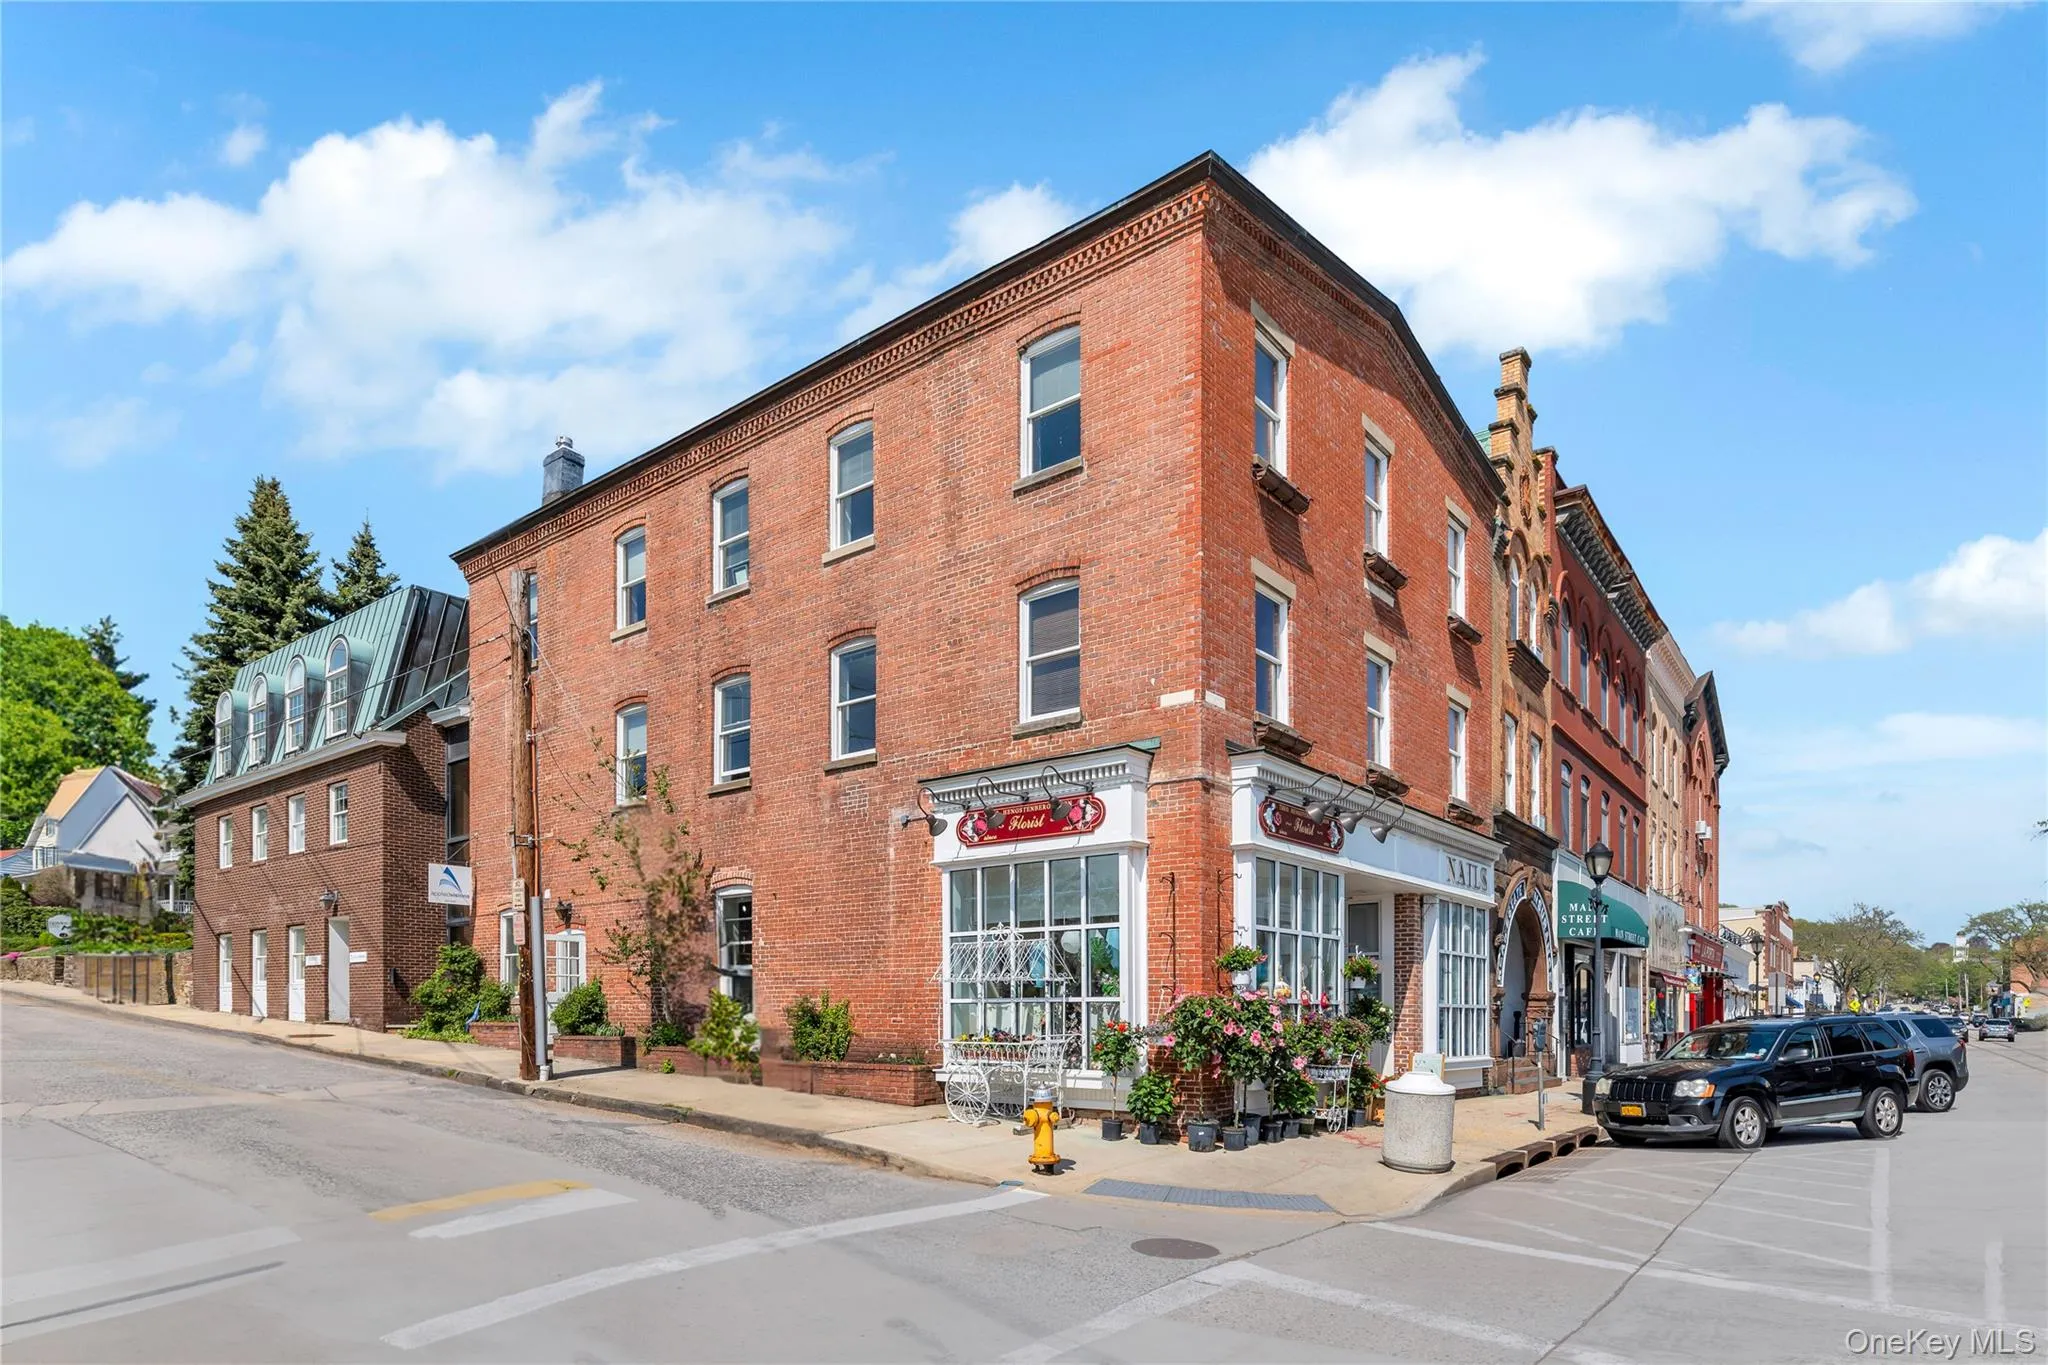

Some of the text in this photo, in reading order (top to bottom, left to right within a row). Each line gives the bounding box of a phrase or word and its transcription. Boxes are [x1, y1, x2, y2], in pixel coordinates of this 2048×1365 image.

[1008, 813, 1045, 831] Florist
[1446, 856, 1488, 892] NAILS
[1569, 903, 1596, 912] MAI
